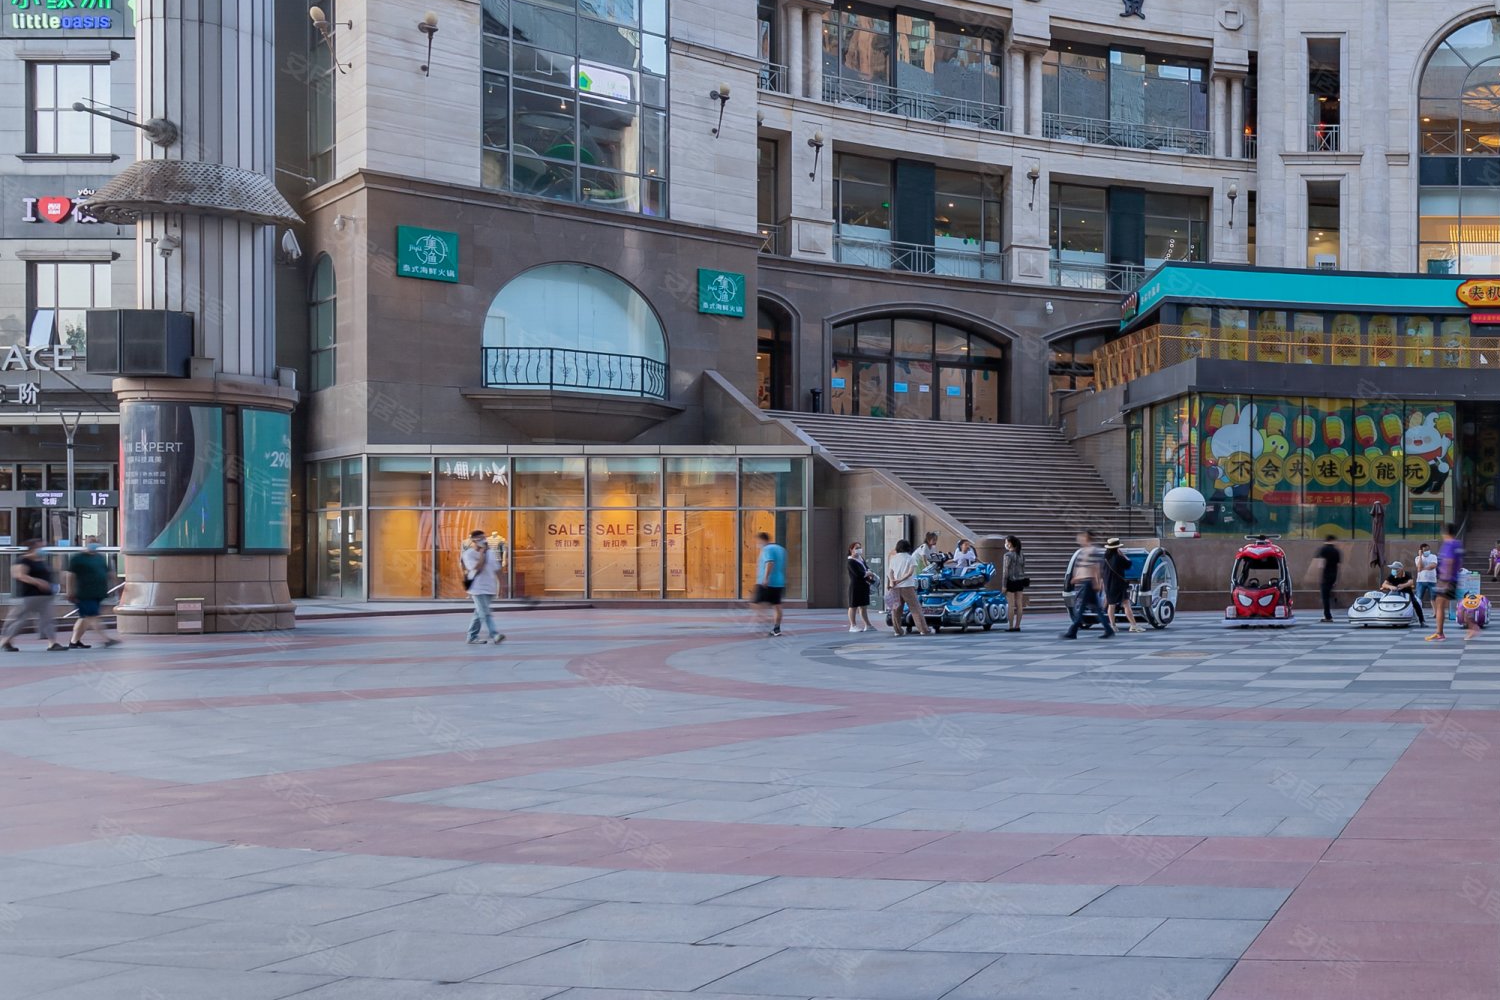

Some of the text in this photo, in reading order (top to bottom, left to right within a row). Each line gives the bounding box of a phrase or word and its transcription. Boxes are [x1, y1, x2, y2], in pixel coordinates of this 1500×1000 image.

[22, 198, 37, 222] I
[135, 442, 184, 453] EXPERT
[1230, 459, 1426, 481] 不会夹娃也能玩
[548, 523, 586, 535] SALE
[595, 523, 635, 535] SALE
